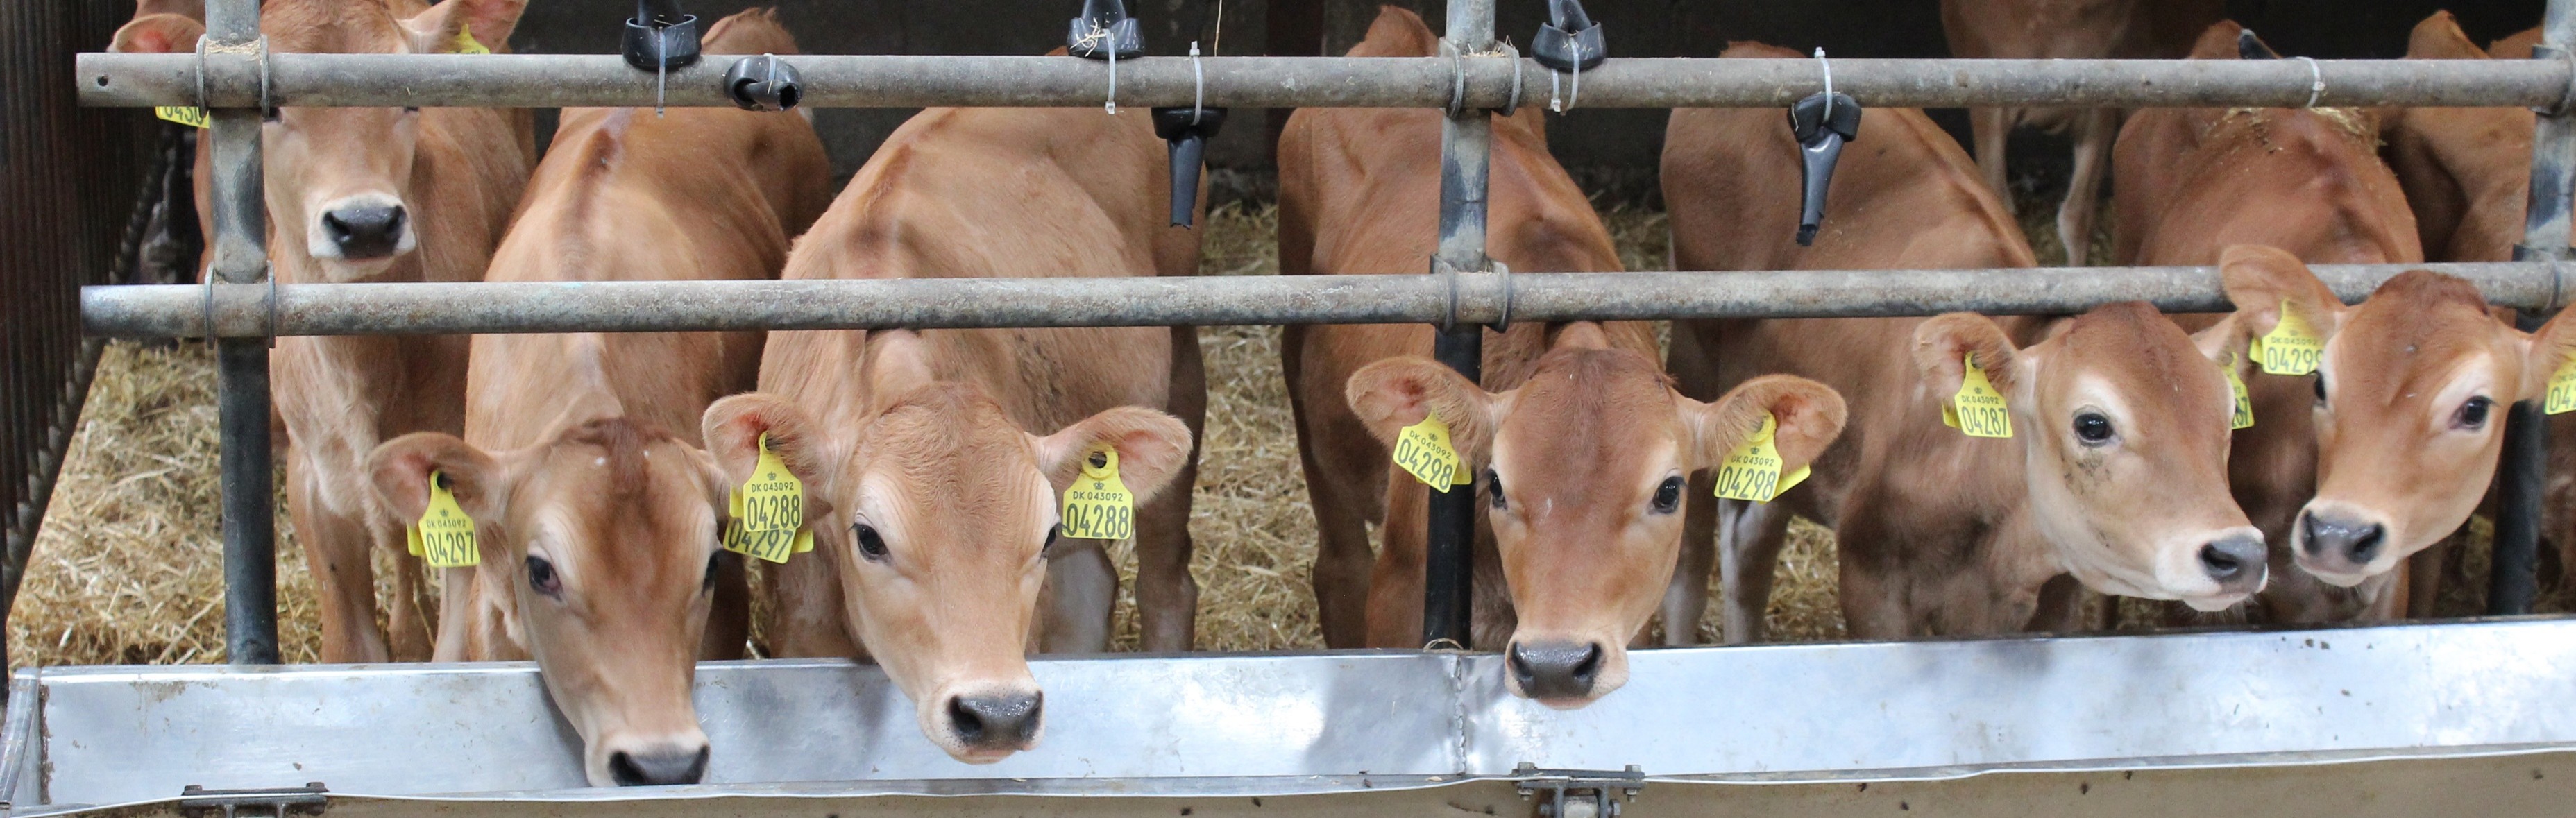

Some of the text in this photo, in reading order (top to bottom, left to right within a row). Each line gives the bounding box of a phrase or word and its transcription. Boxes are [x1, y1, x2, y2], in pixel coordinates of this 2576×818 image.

[1972, 395, 1999, 404] 043092
[1961, 406, 2007, 436] 04287
[1409, 430, 1452, 459] DK 043092
[1398, 438, 1453, 490] 04298
[1743, 456, 1774, 466] 043092
[752, 482, 794, 493] DK 043092
[1073, 491, 1123, 502] DK 043092
[1719, 466, 1777, 500] 04298
[747, 494, 800, 531] 04288
[1067, 503, 1129, 538] 04288
[426, 531, 474, 564] 04297
